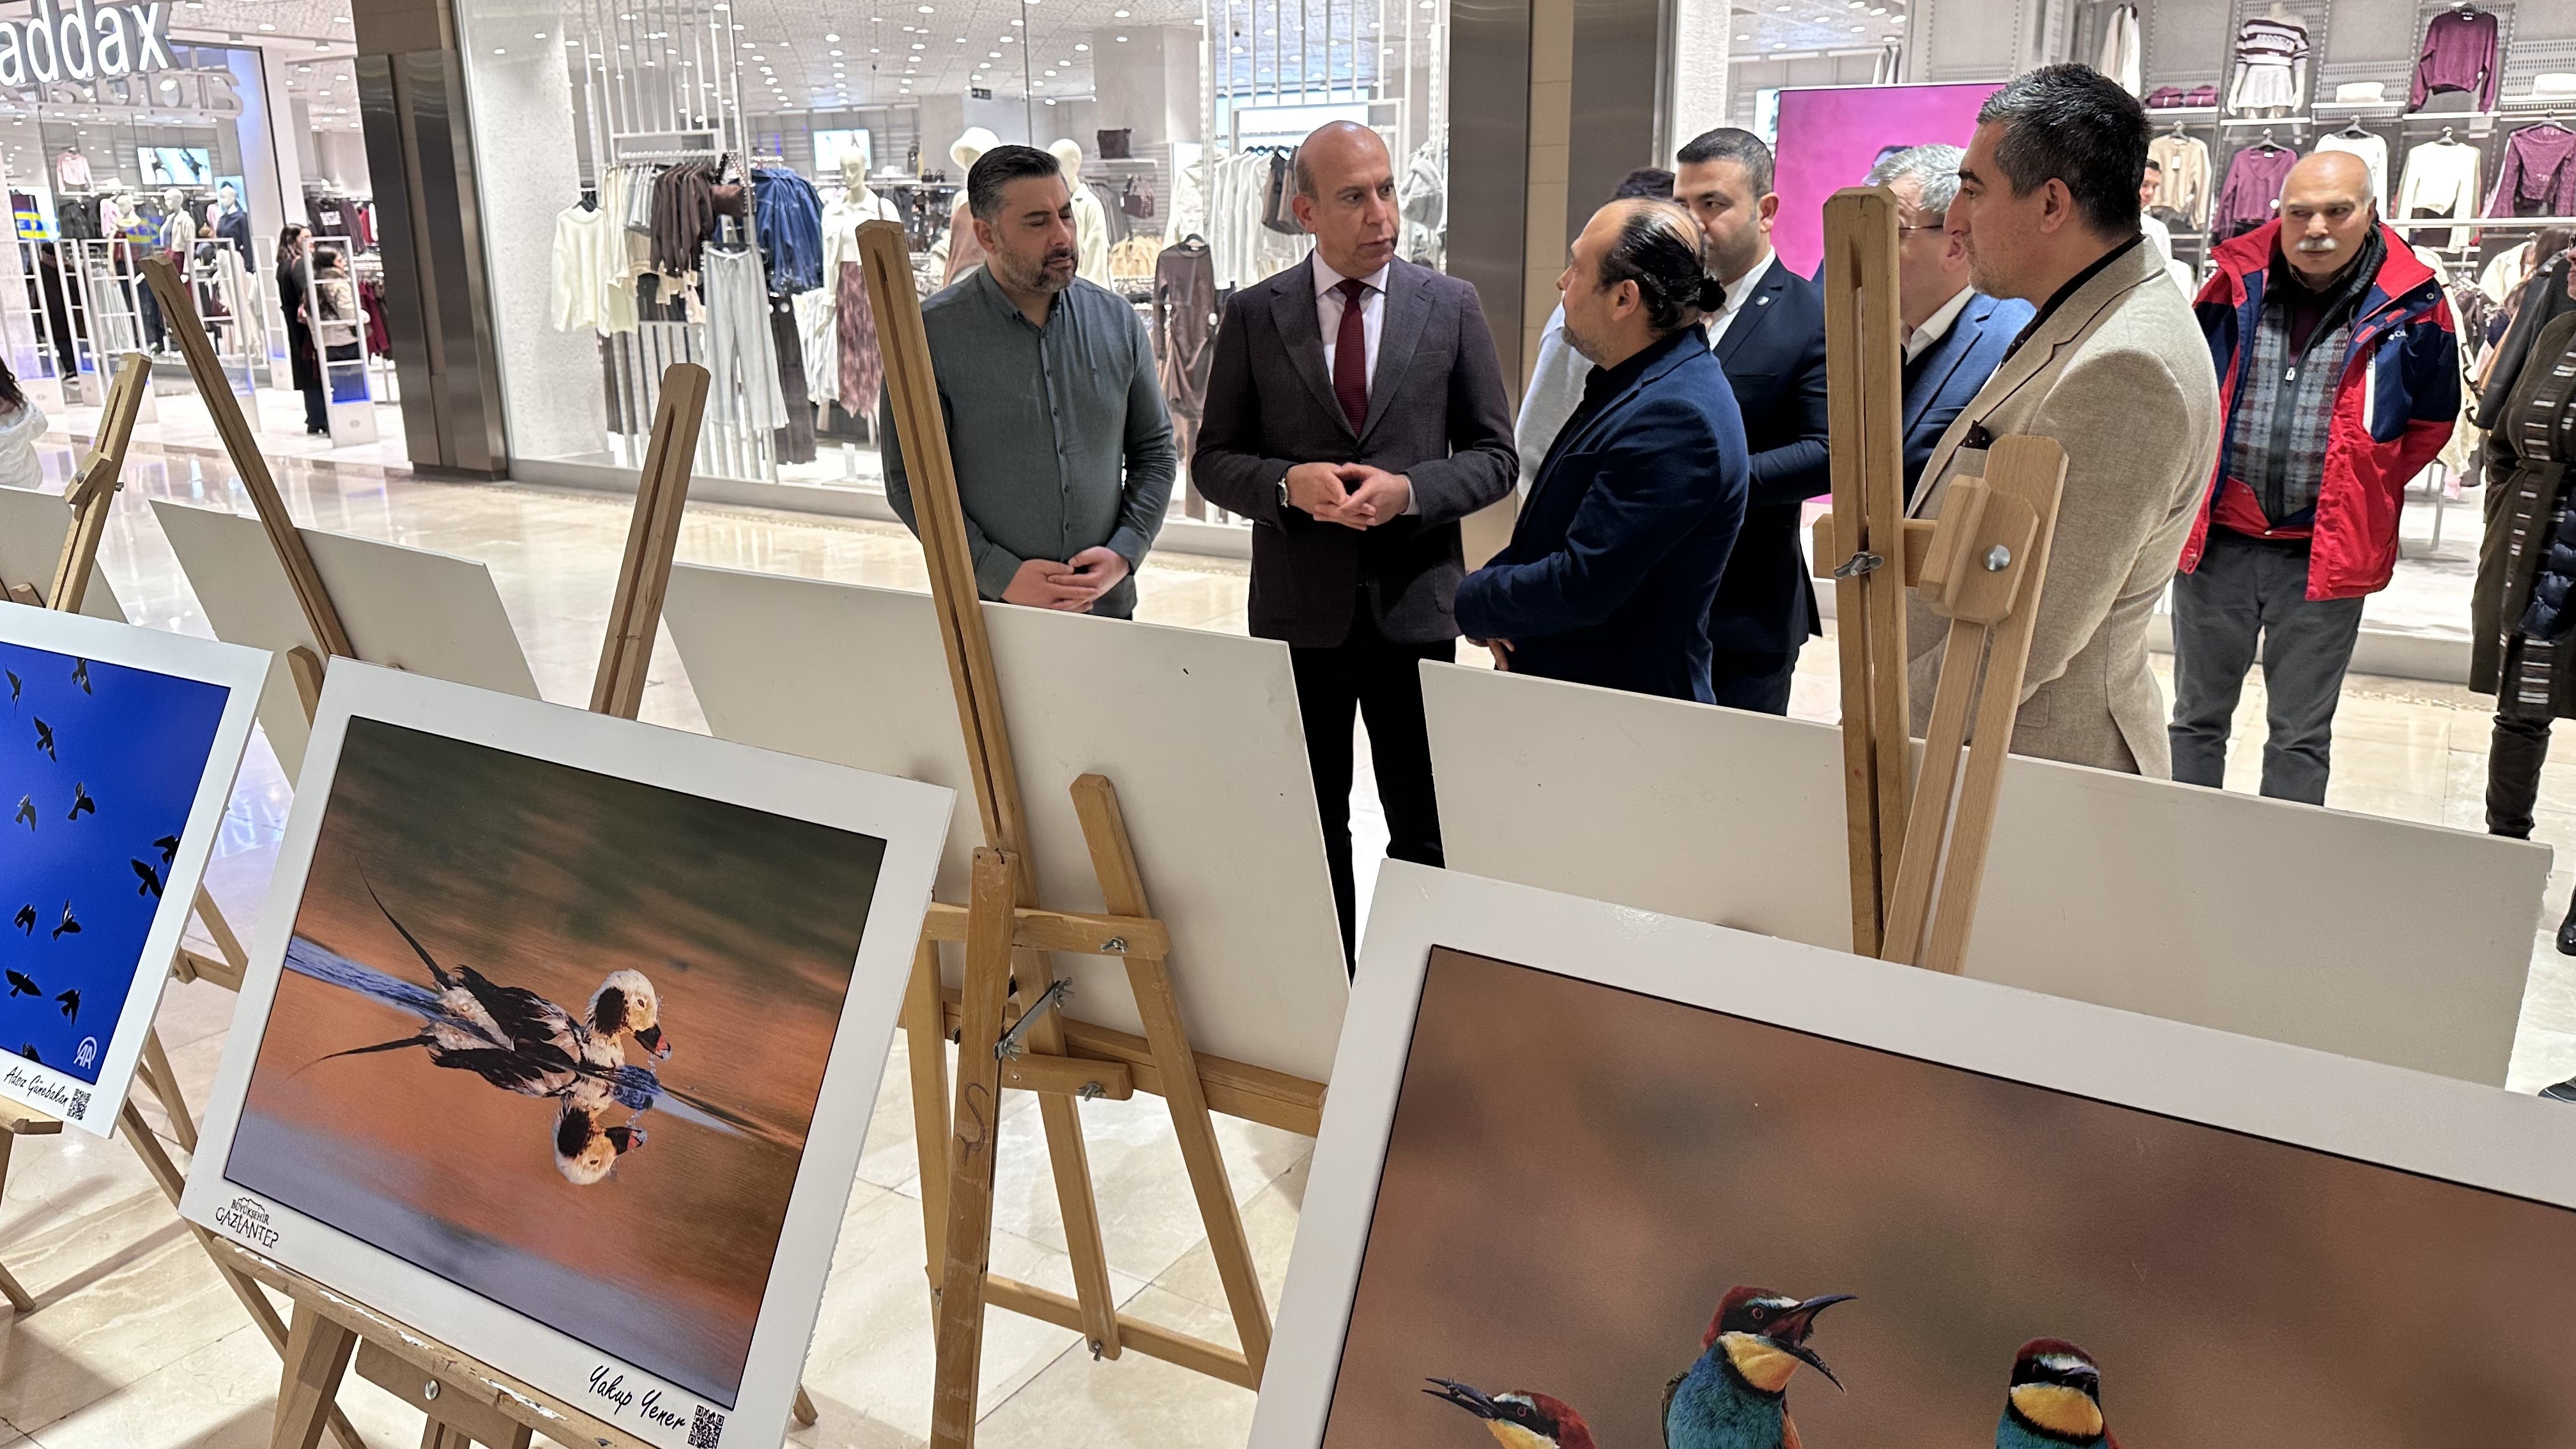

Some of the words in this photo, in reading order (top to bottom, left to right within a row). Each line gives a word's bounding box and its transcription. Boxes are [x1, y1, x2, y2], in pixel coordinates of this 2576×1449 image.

[0, 0, 169, 86] addax
[27, 1075, 68, 1107] Günebakan
[215, 1207, 279, 1248] GAZİANTEP
[588, 1365, 634, 1415] Yakup
[640, 1389, 686, 1430] Yener
